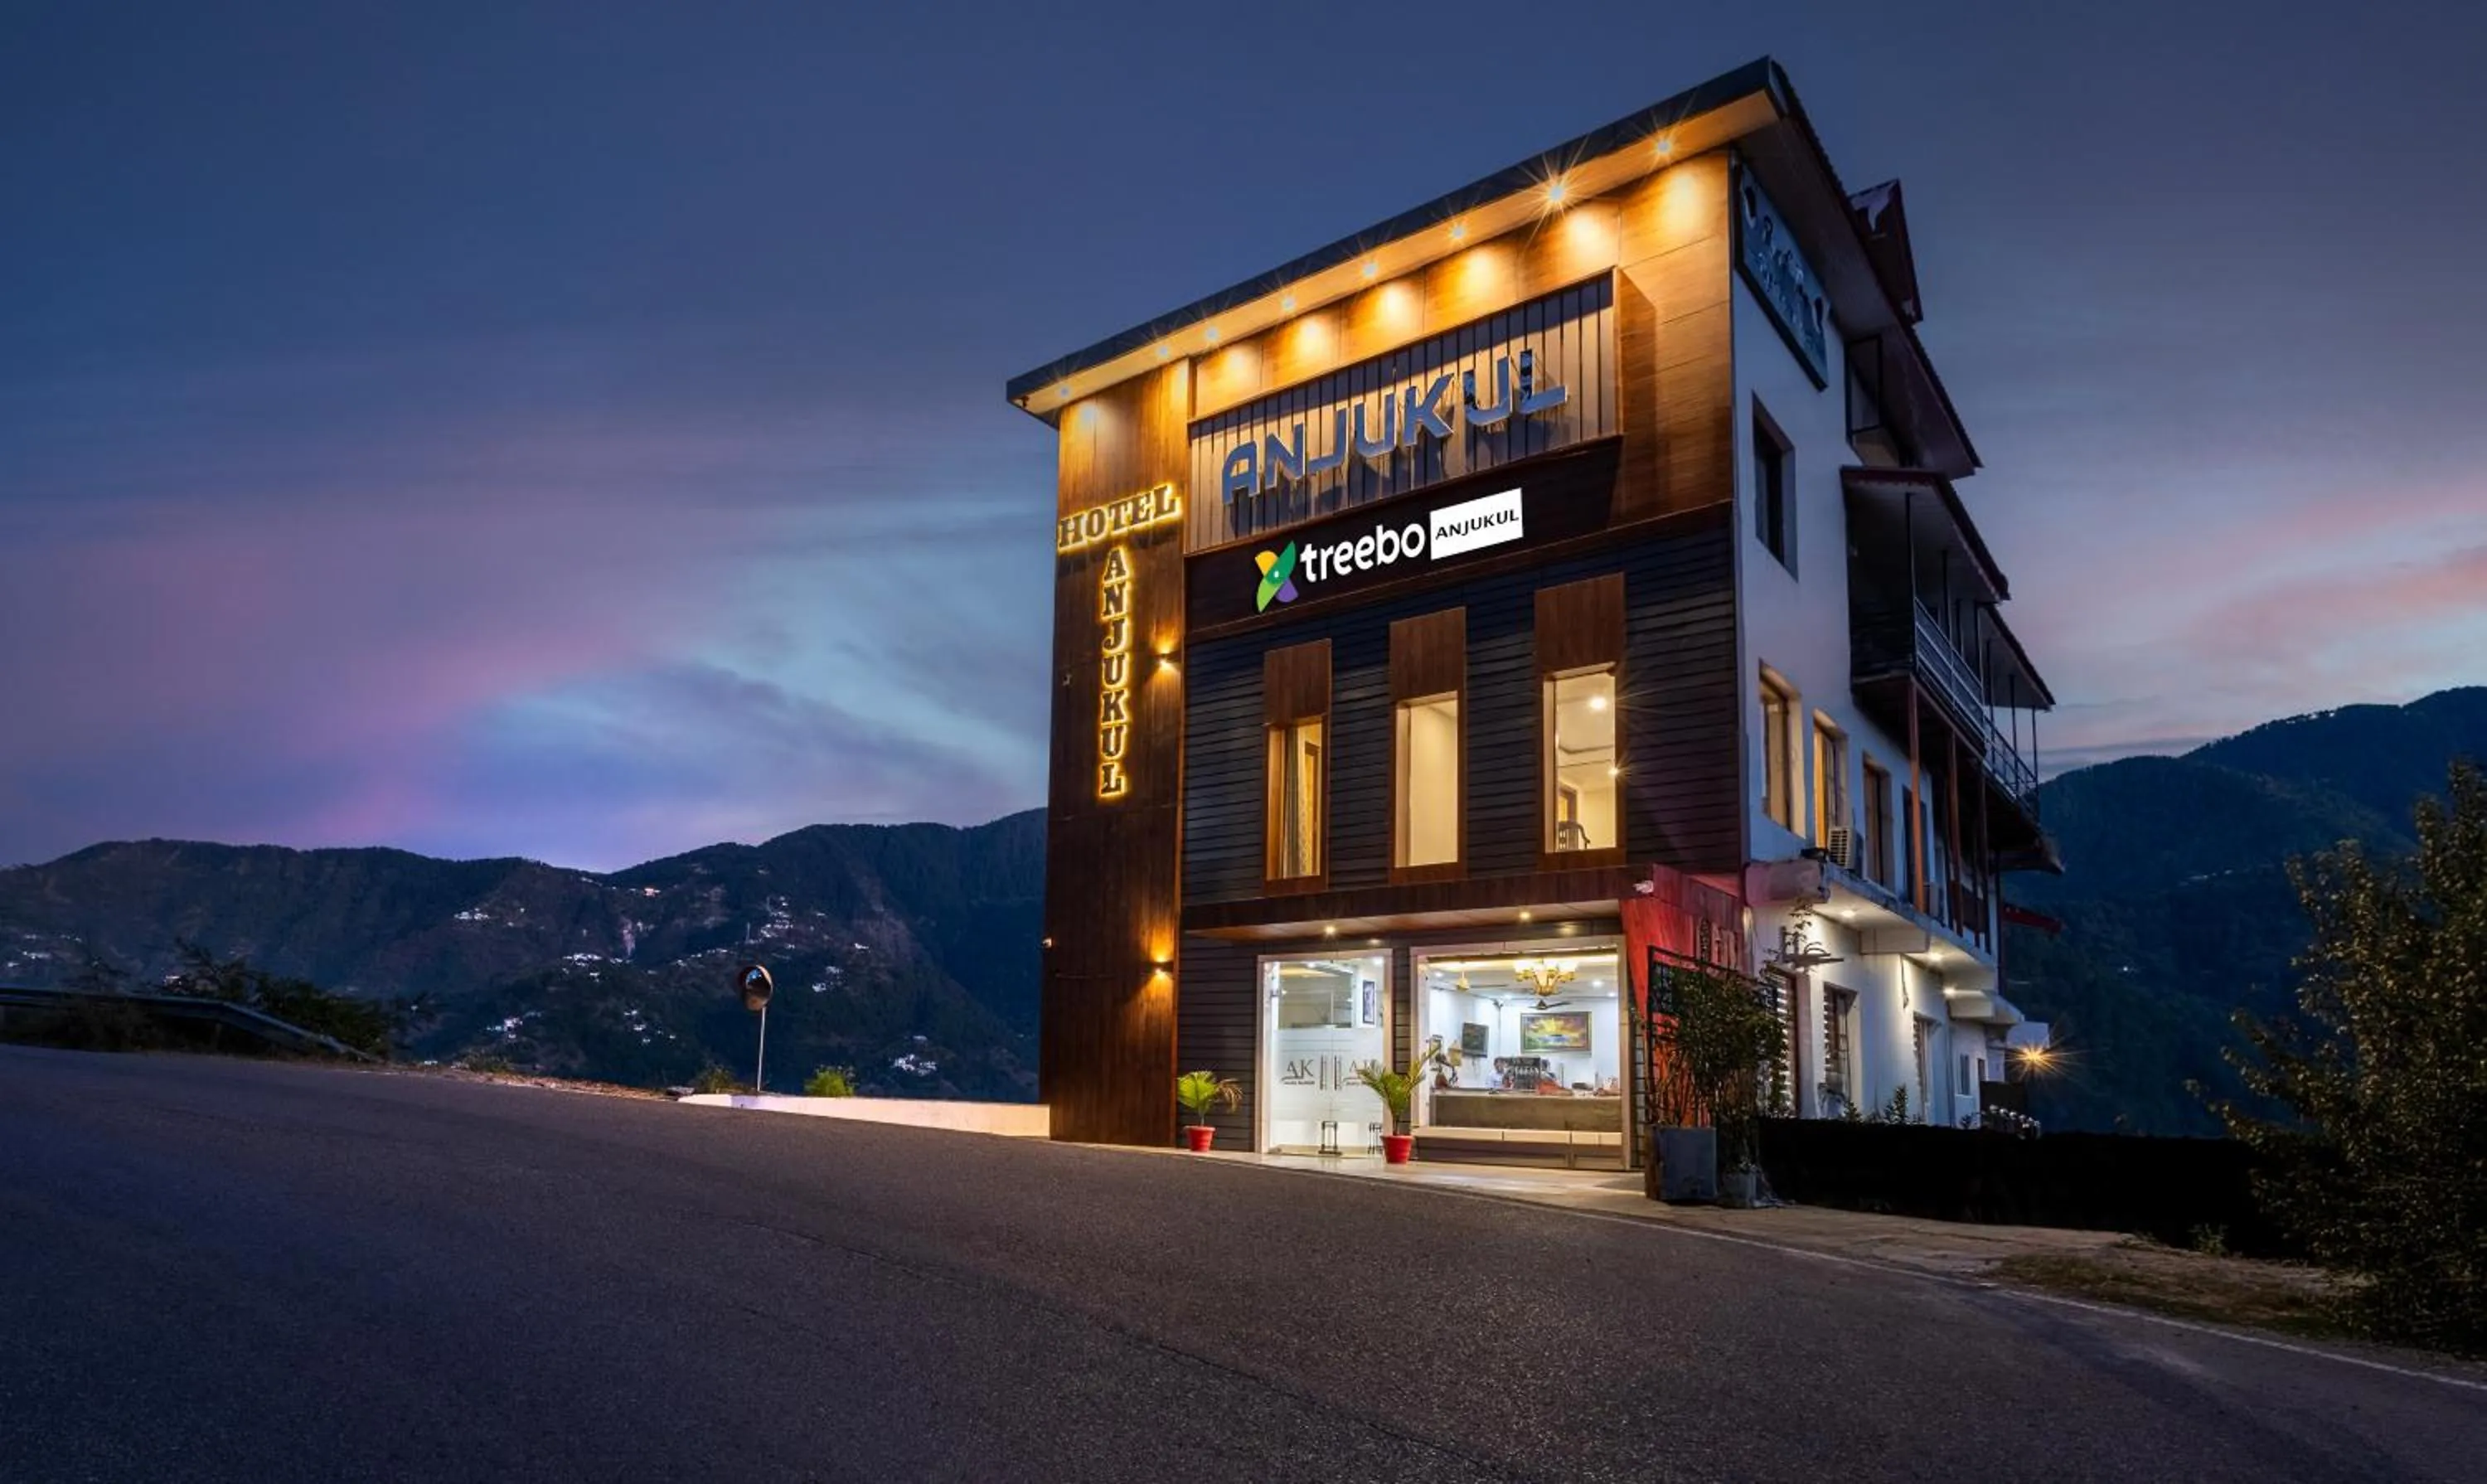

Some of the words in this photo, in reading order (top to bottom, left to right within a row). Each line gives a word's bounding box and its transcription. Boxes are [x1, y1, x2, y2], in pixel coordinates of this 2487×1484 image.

[1222, 349, 1568, 504] ANJUKUL
[1058, 484, 1180, 551] HOTEL
[1300, 523, 1426, 582] treebo
[1435, 508, 1520, 541] ANJUKUL
[1100, 546, 1129, 797] ANJUKUL
